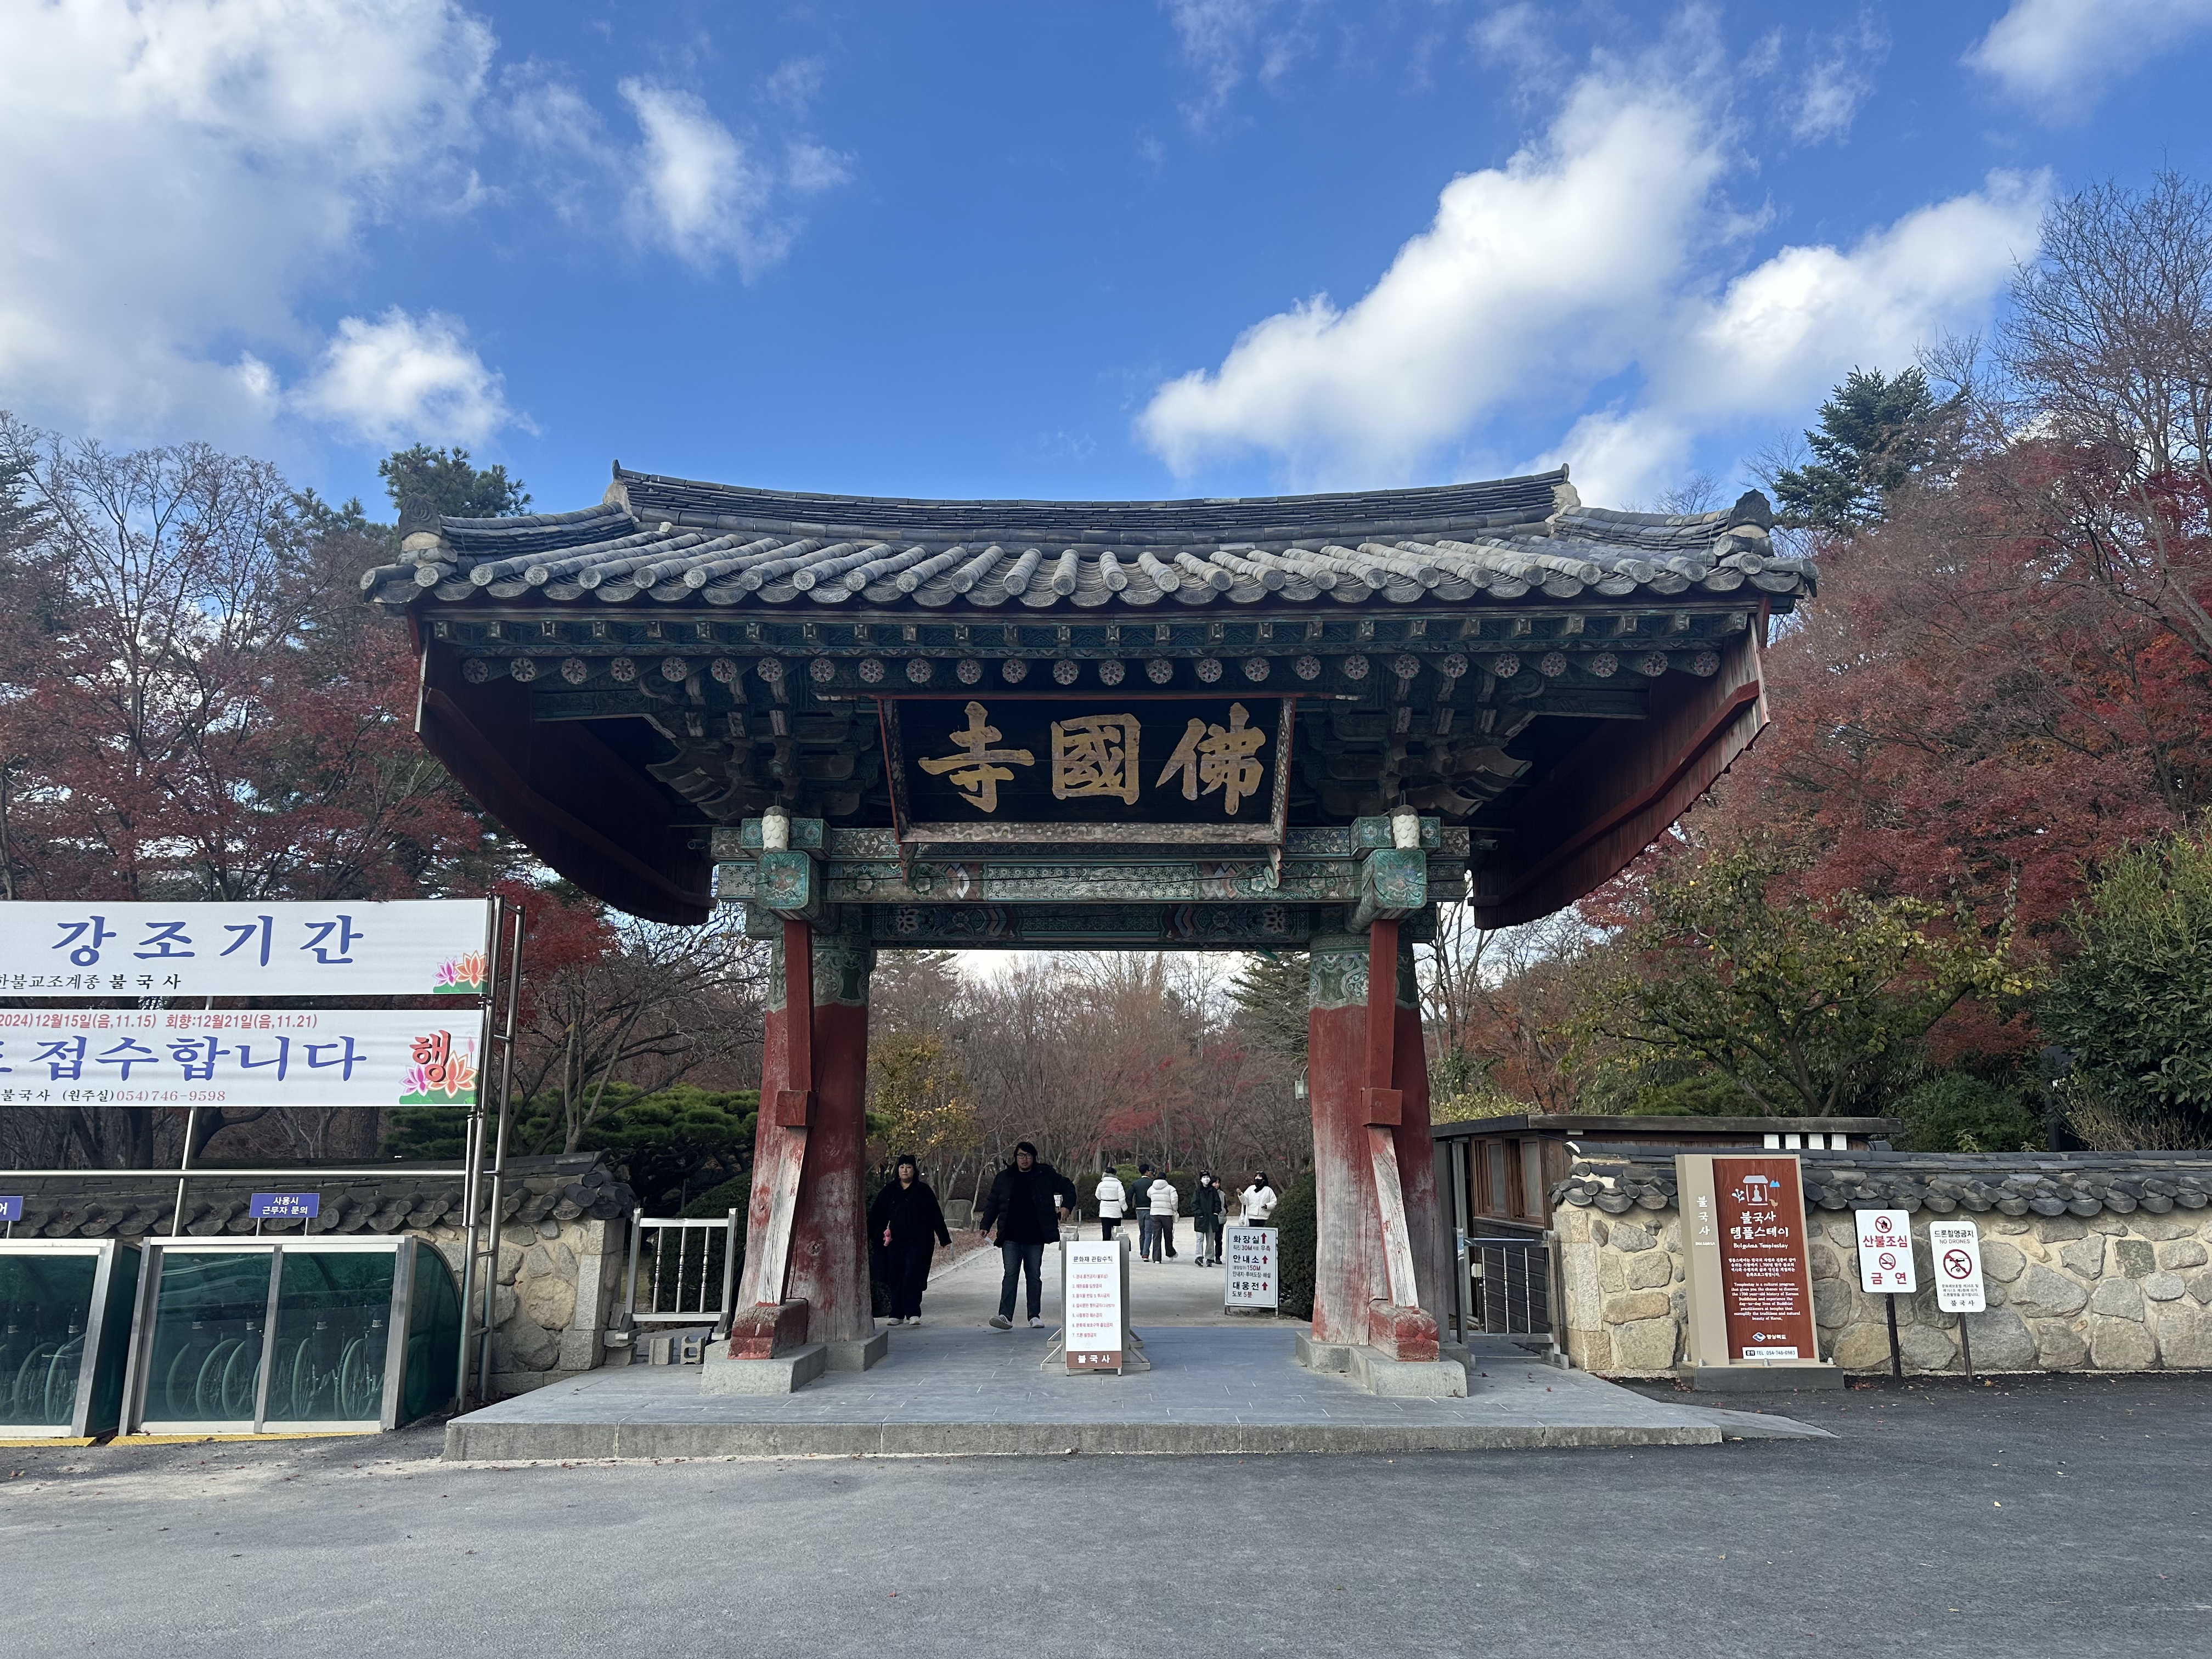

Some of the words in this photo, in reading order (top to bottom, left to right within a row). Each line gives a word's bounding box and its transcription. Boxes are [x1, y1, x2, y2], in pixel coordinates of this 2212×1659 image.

[918, 701, 1266, 815] 佛國寺
[52, 915, 364, 967] 강조기간
[109, 974, 181, 990] 불국사
[30, 1035, 367, 1081] 접수합니다
[409, 1030, 451, 1082] 행
[1, 1088, 50, 1102] 불국사
[273, 1197, 298, 1205] 사용시
[1696, 1195, 1711, 1235] 불국사
[1740, 1211, 1776, 1224] 불국사
[1233, 1235, 1259, 1244] 화장실
[1730, 1226, 1788, 1240] 템플스테이
[1863, 1235, 1908, 1248] 산불조심
[1233, 1255, 1259, 1263] 안내소
[1233, 1282, 1259, 1290] 대웅전
[1077, 1355, 1110, 1363] 불국사
